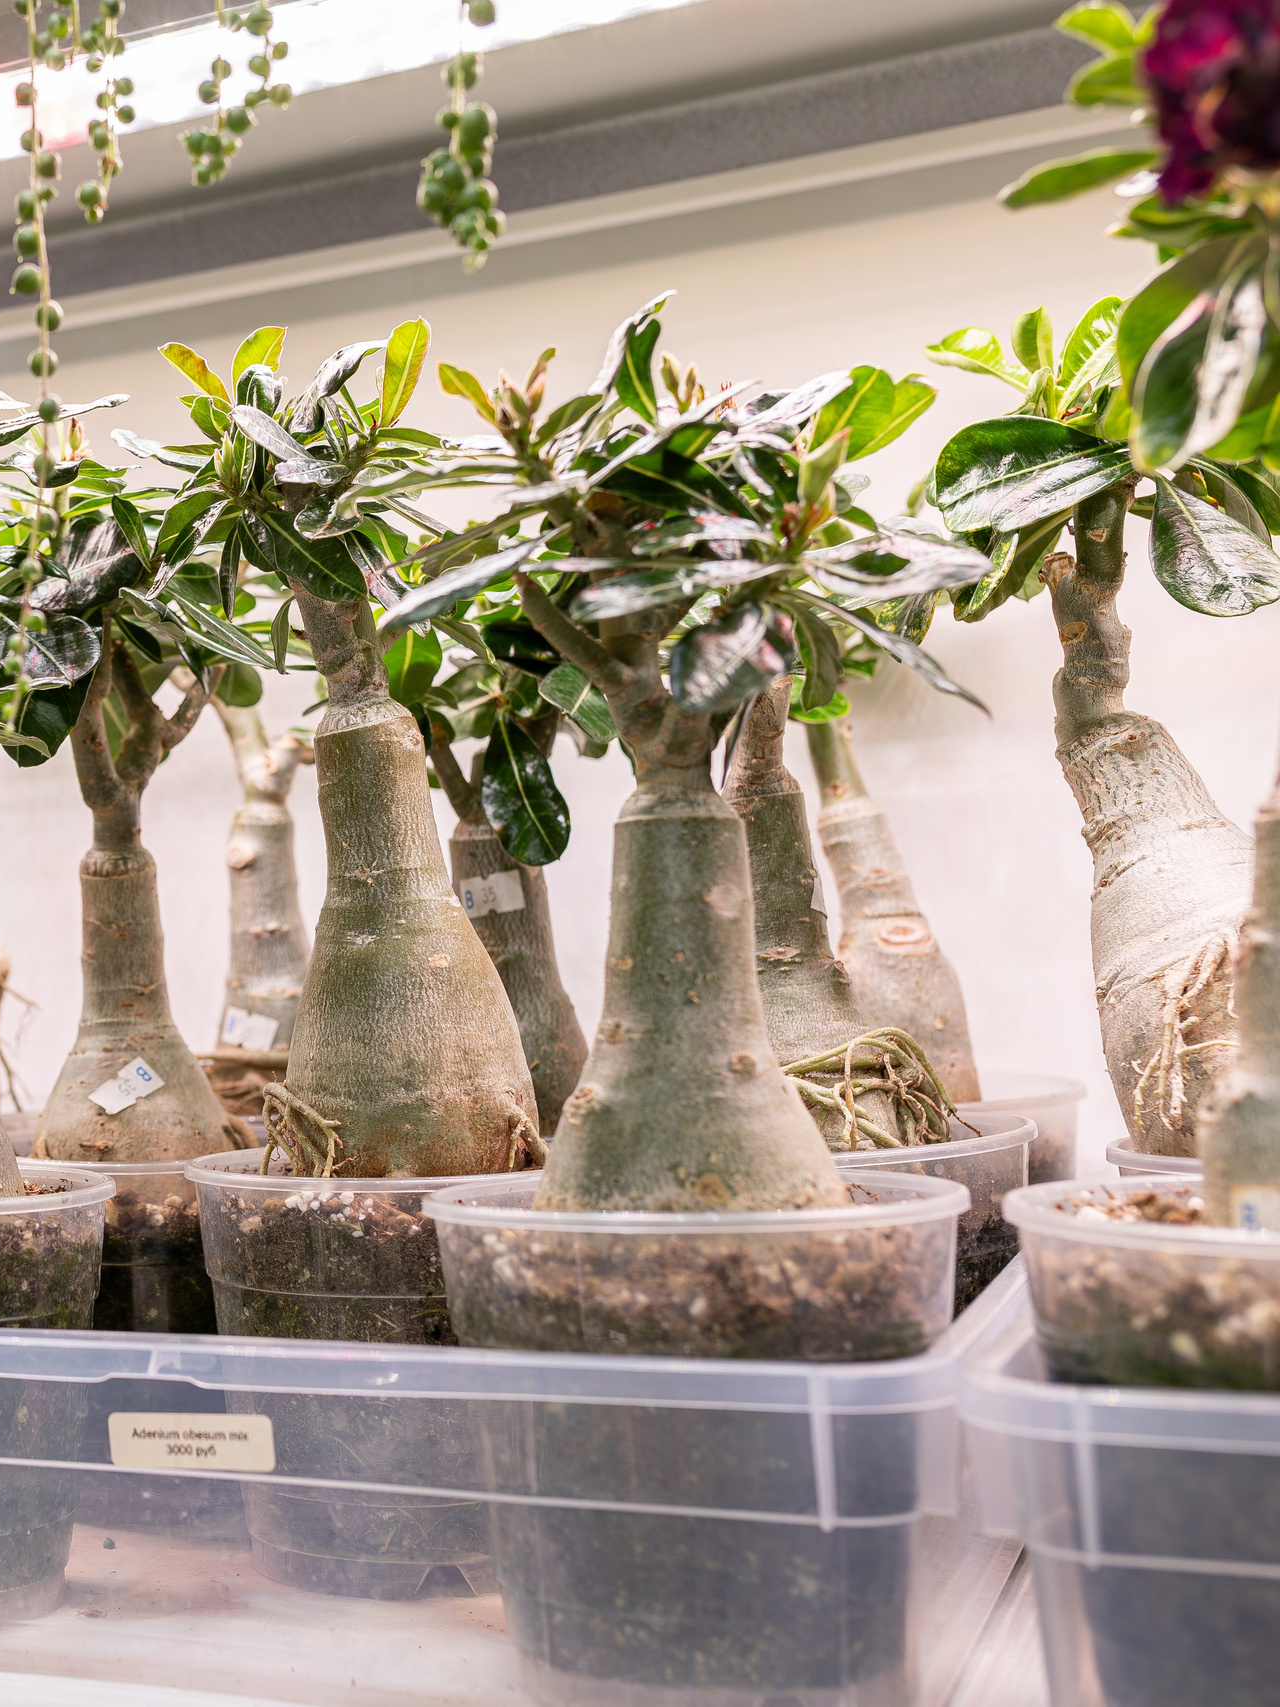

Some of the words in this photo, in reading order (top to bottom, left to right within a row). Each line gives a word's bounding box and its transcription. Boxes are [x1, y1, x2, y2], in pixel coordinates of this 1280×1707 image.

[481, 885, 497, 905] 35
[118, 1078, 137, 1096] 35
[131, 1427, 180, 1440] Adenium
[183, 1428, 227, 1441] obesum
[229, 1429, 250, 1442] mix
[166, 1444, 193, 1456] 3000
[196, 1445, 217, 1458] руб
